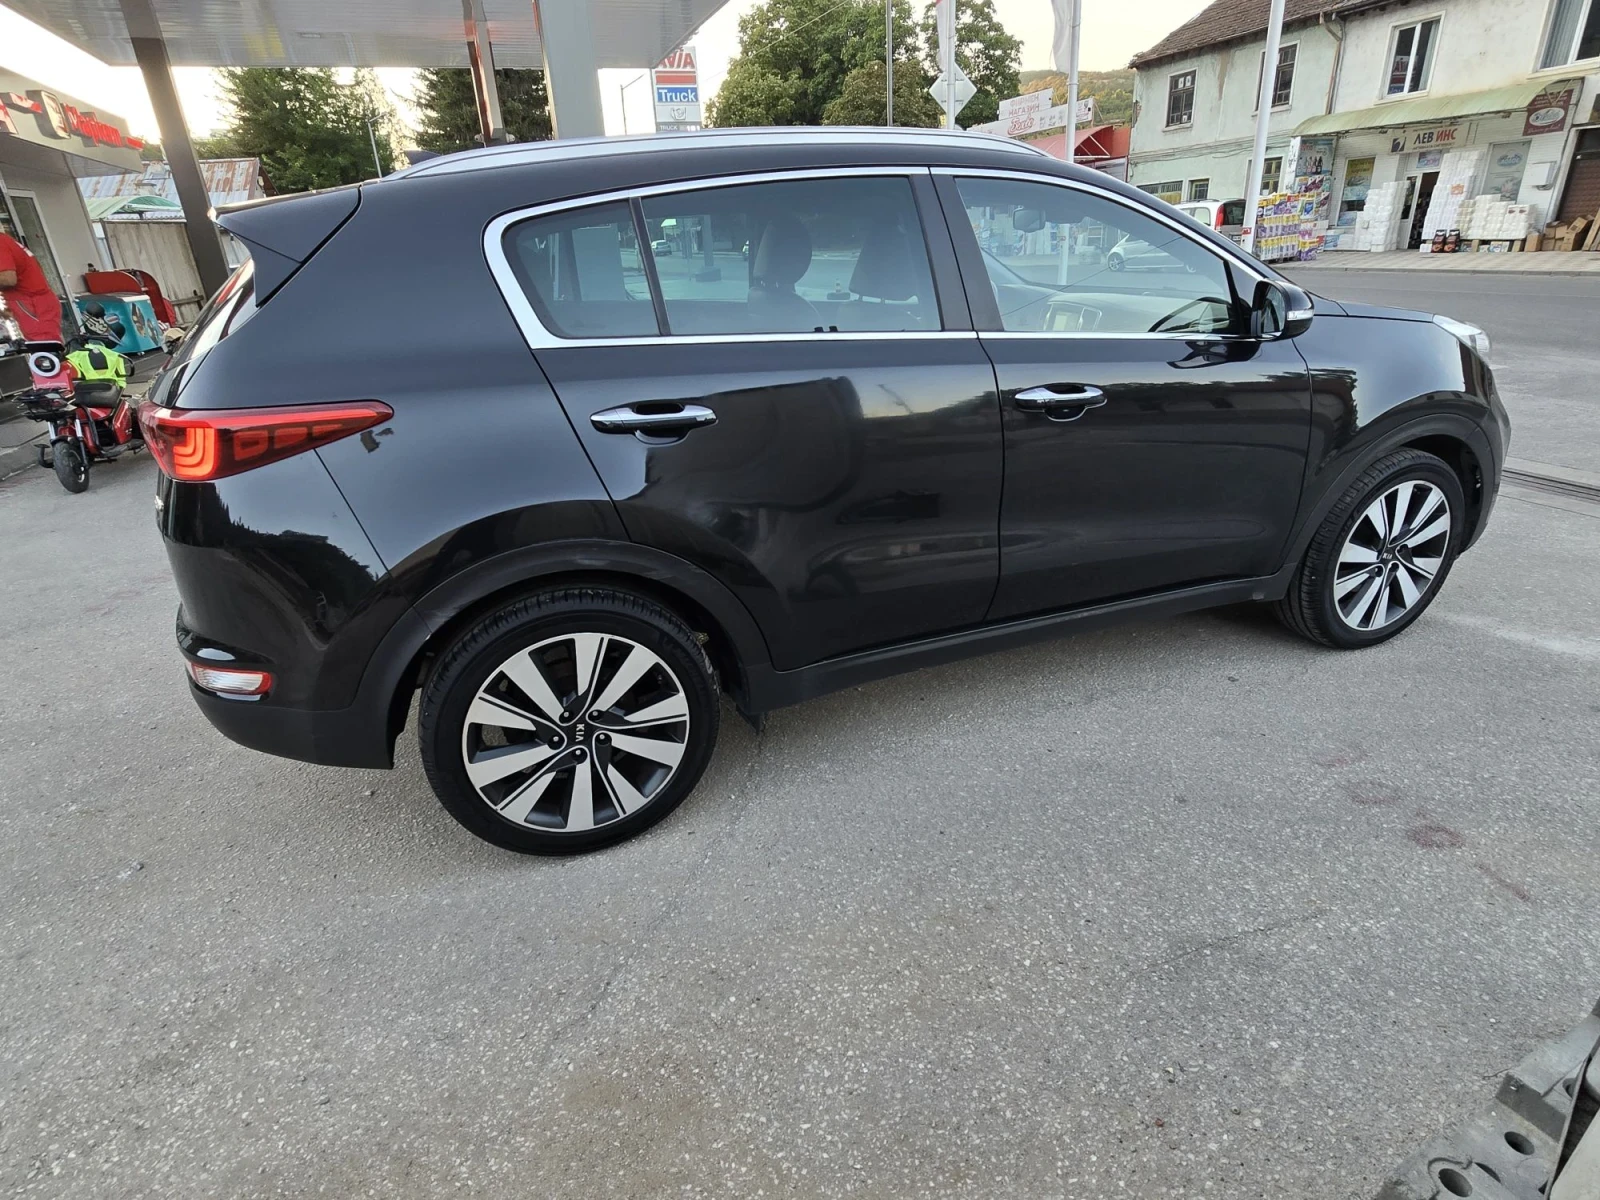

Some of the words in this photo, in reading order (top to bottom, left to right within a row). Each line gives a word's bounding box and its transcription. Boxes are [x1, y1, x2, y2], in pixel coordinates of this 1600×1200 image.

[659, 89, 696, 102] Truck
[1413, 131, 1434, 144] ЛЕВ
[1436, 128, 1457, 142] ИНС
[1382, 552, 1393, 560] KIA
[575, 723, 585, 742] KIA
